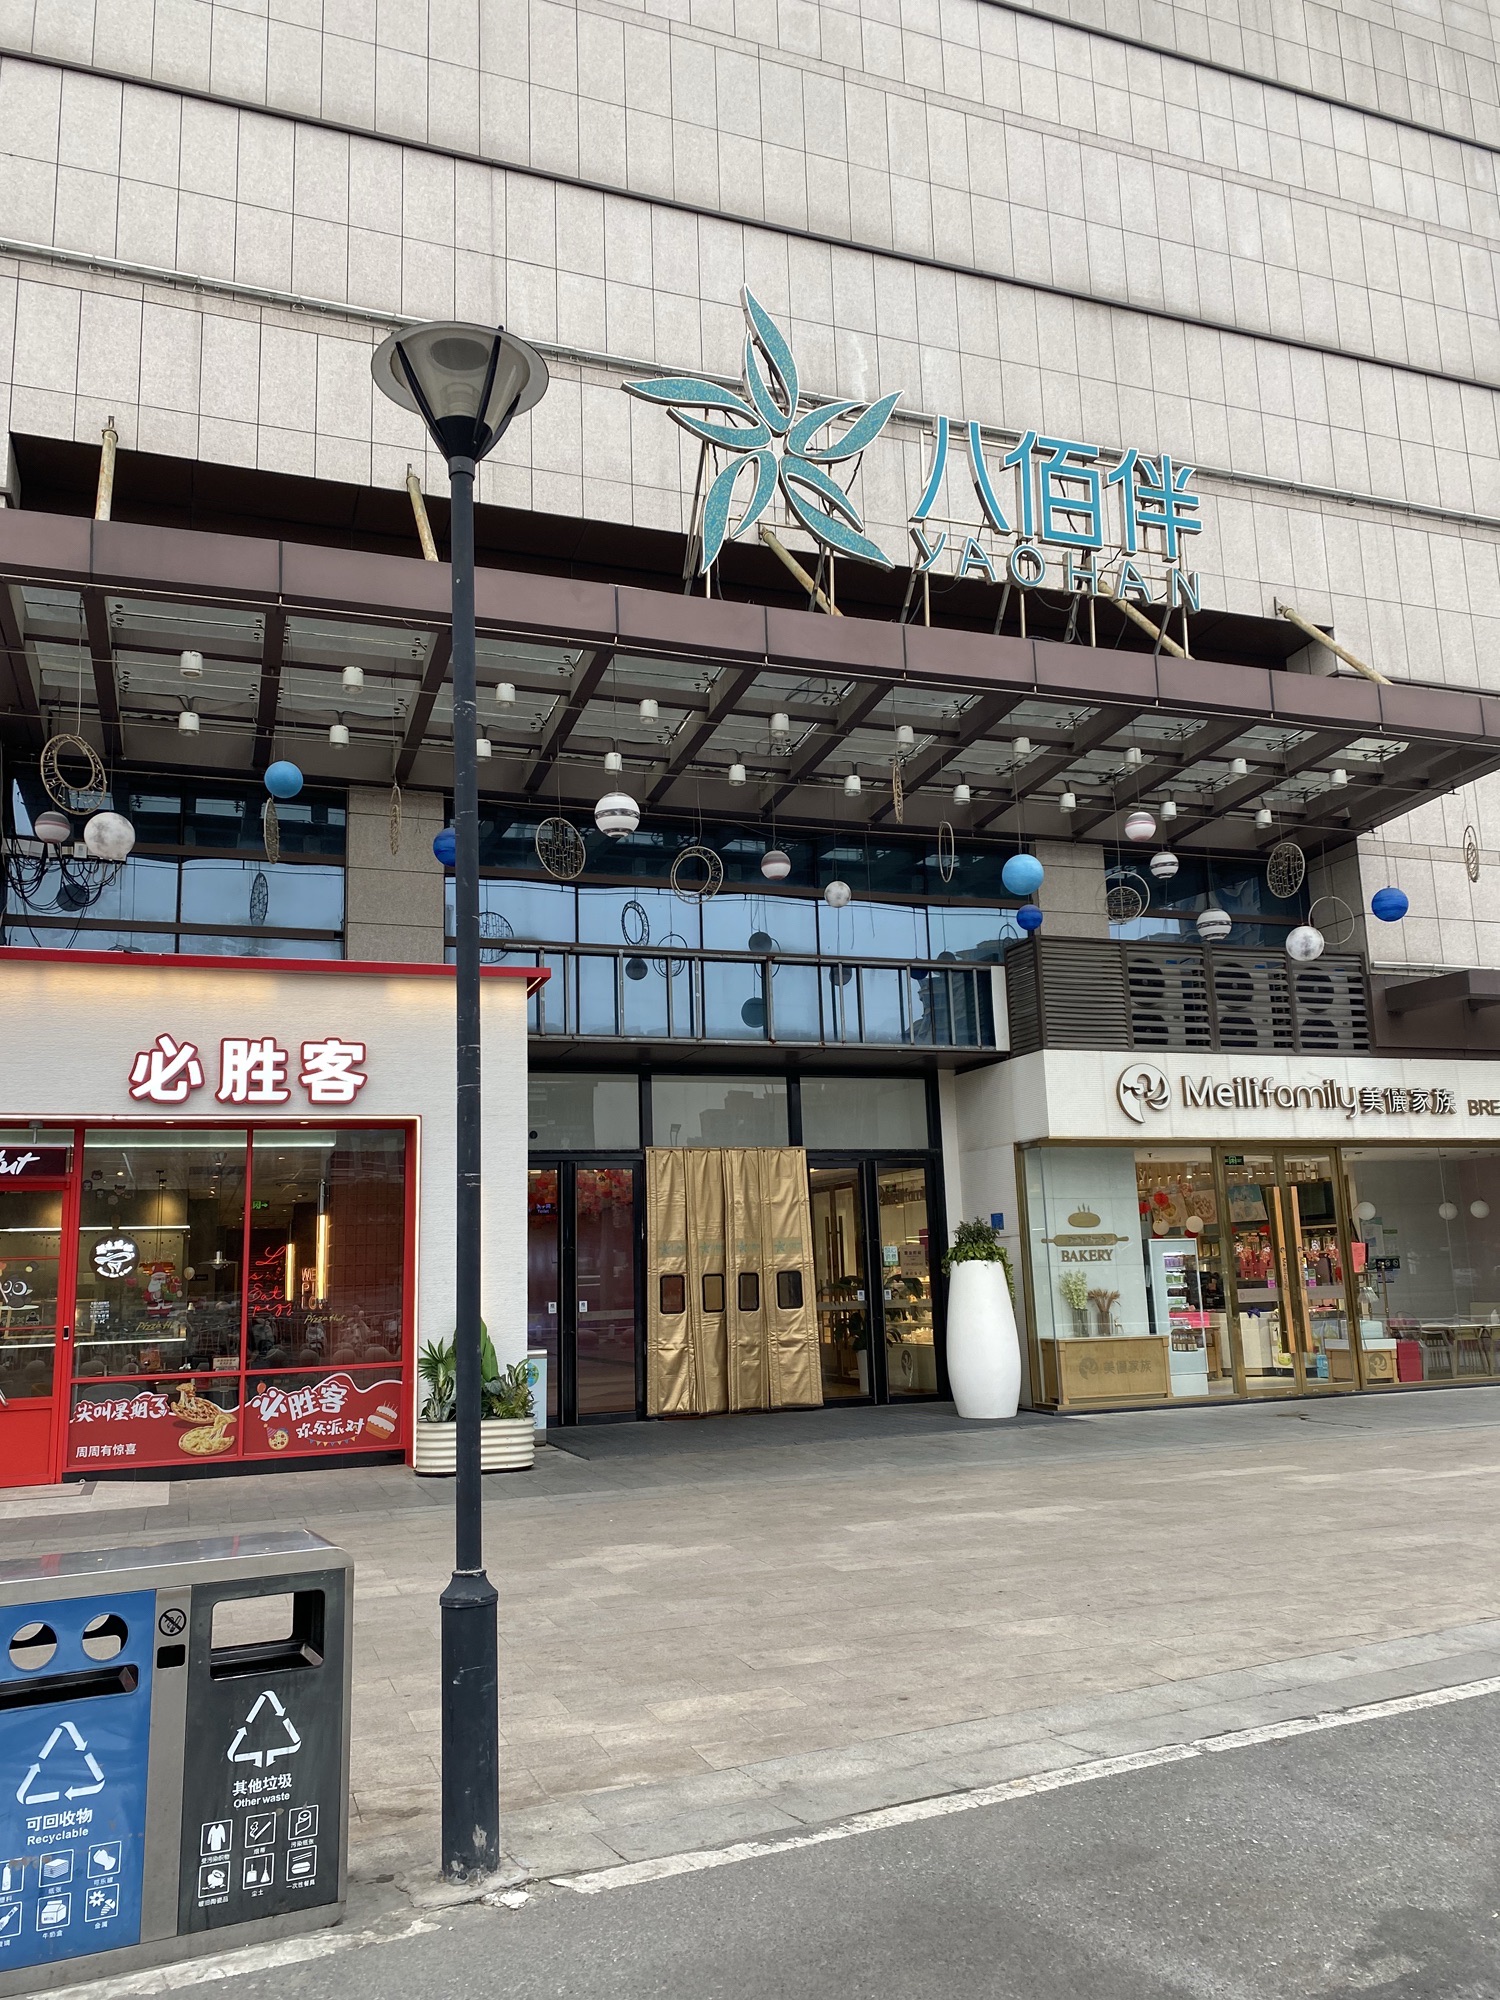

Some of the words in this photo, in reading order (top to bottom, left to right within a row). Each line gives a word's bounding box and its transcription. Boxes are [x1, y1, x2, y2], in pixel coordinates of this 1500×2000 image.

[909, 415, 1202, 562] 八佰伴
[909, 527, 1200, 614] YAOHAN
[128, 1033, 367, 1104] 必胜客
[1181, 1075, 1359, 1119] Meilifamily
[1467, 1099, 1500, 1116] BRE
[1061, 1249, 1113, 1262] BAKERY
[252, 1384, 348, 1422] 必胜客
[295, 1417, 365, 1439] 欢乐派对
[75, 1443, 137, 1458] 周周有惊喜
[232, 1773, 293, 1796] 其他垃圾
[233, 1796, 261, 1808] Other
[262, 1792, 291, 1804] waste
[26, 1807, 93, 1832] 可回收物
[27, 1827, 89, 1846] Recyclable
[48, 1886, 62, 1895] 纸张
[251, 1889, 264, 1897] 尘土
[286, 1879, 315, 1889] 一次性餐具
[94, 1920, 108, 1929] 金属
[42, 1929, 63, 1939] 牛奶盒
